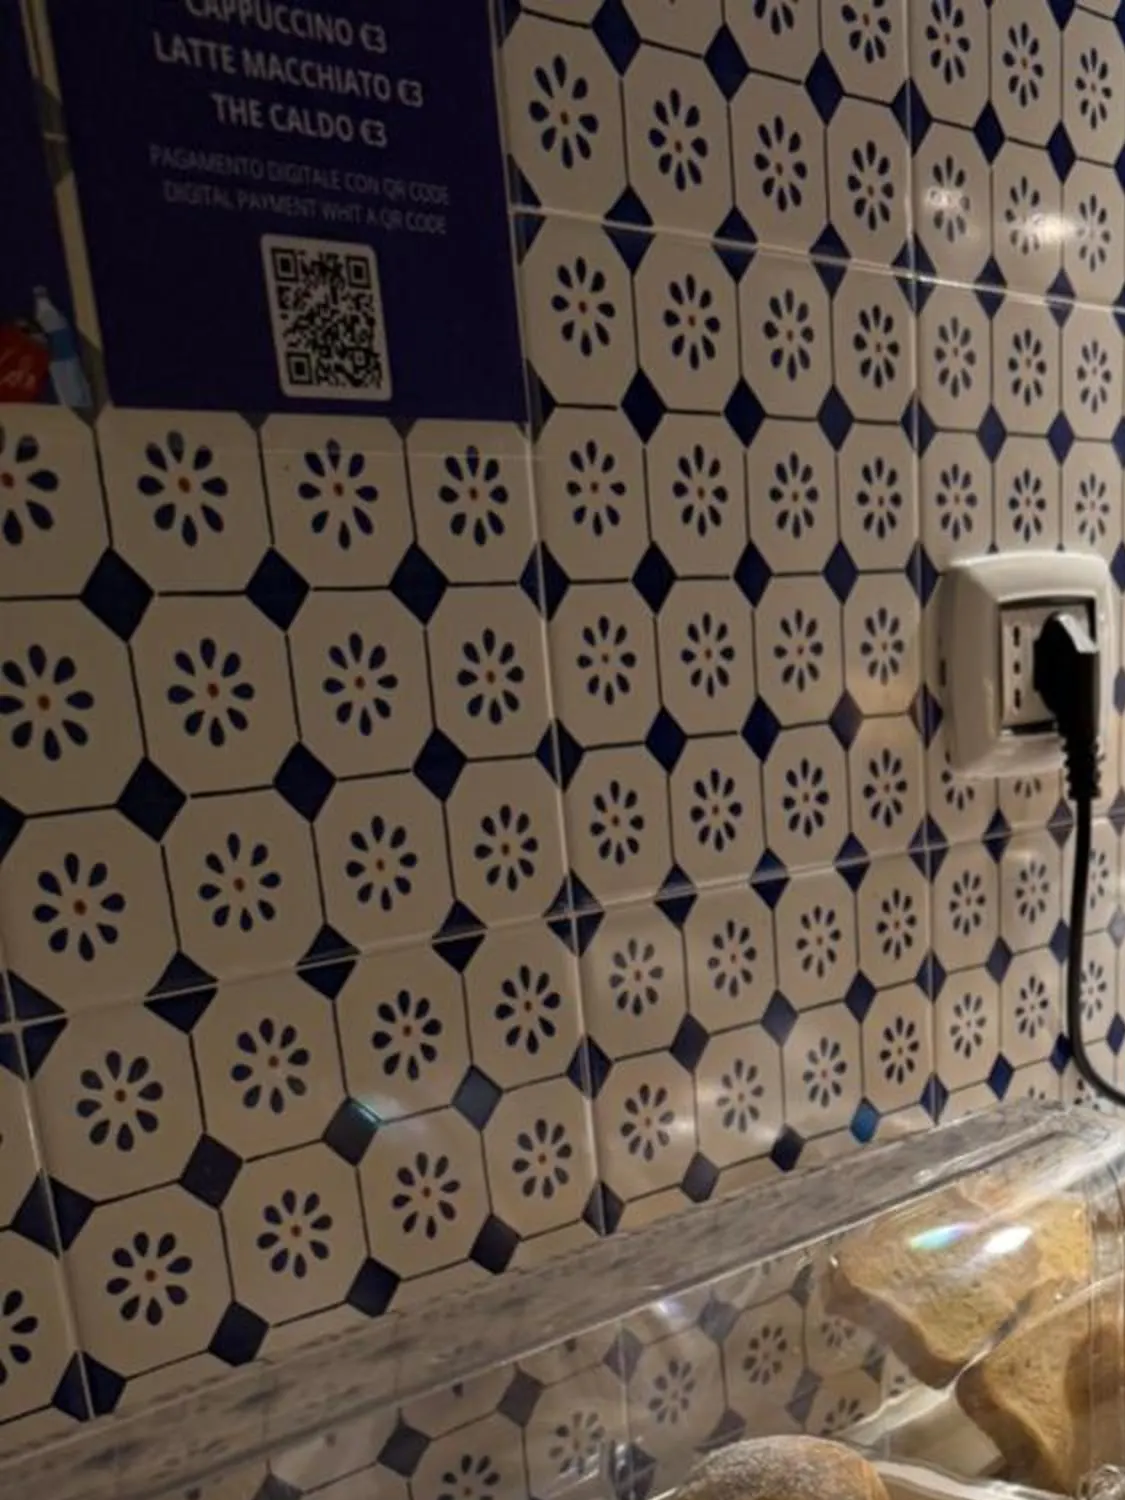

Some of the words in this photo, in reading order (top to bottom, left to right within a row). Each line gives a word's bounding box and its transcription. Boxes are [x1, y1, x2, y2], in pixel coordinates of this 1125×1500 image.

[185, 0, 353, 47] CAPPUCCINO
[360, 22, 388, 54] €3
[152, 31, 236, 75] LATTE
[242, 49, 391, 102] MACCHIATO
[397, 78, 424, 108] €3
[210, 92, 264, 128] THE
[269, 103, 353, 142] CALDO
[360, 118, 388, 148] €3
[148, 143, 264, 179] PAGAMENTO
[267, 161, 341, 190] DIGITALE
[344, 172, 380, 194] CON
[382, 177, 406, 199] QR
[408, 181, 450, 206] CODE
[162, 179, 234, 210] DIGITAL
[237, 190, 317, 218] PAYMENT
[365, 207, 377, 225] A
[379, 209, 403, 231] QR
[405, 211, 447, 235] CODE
